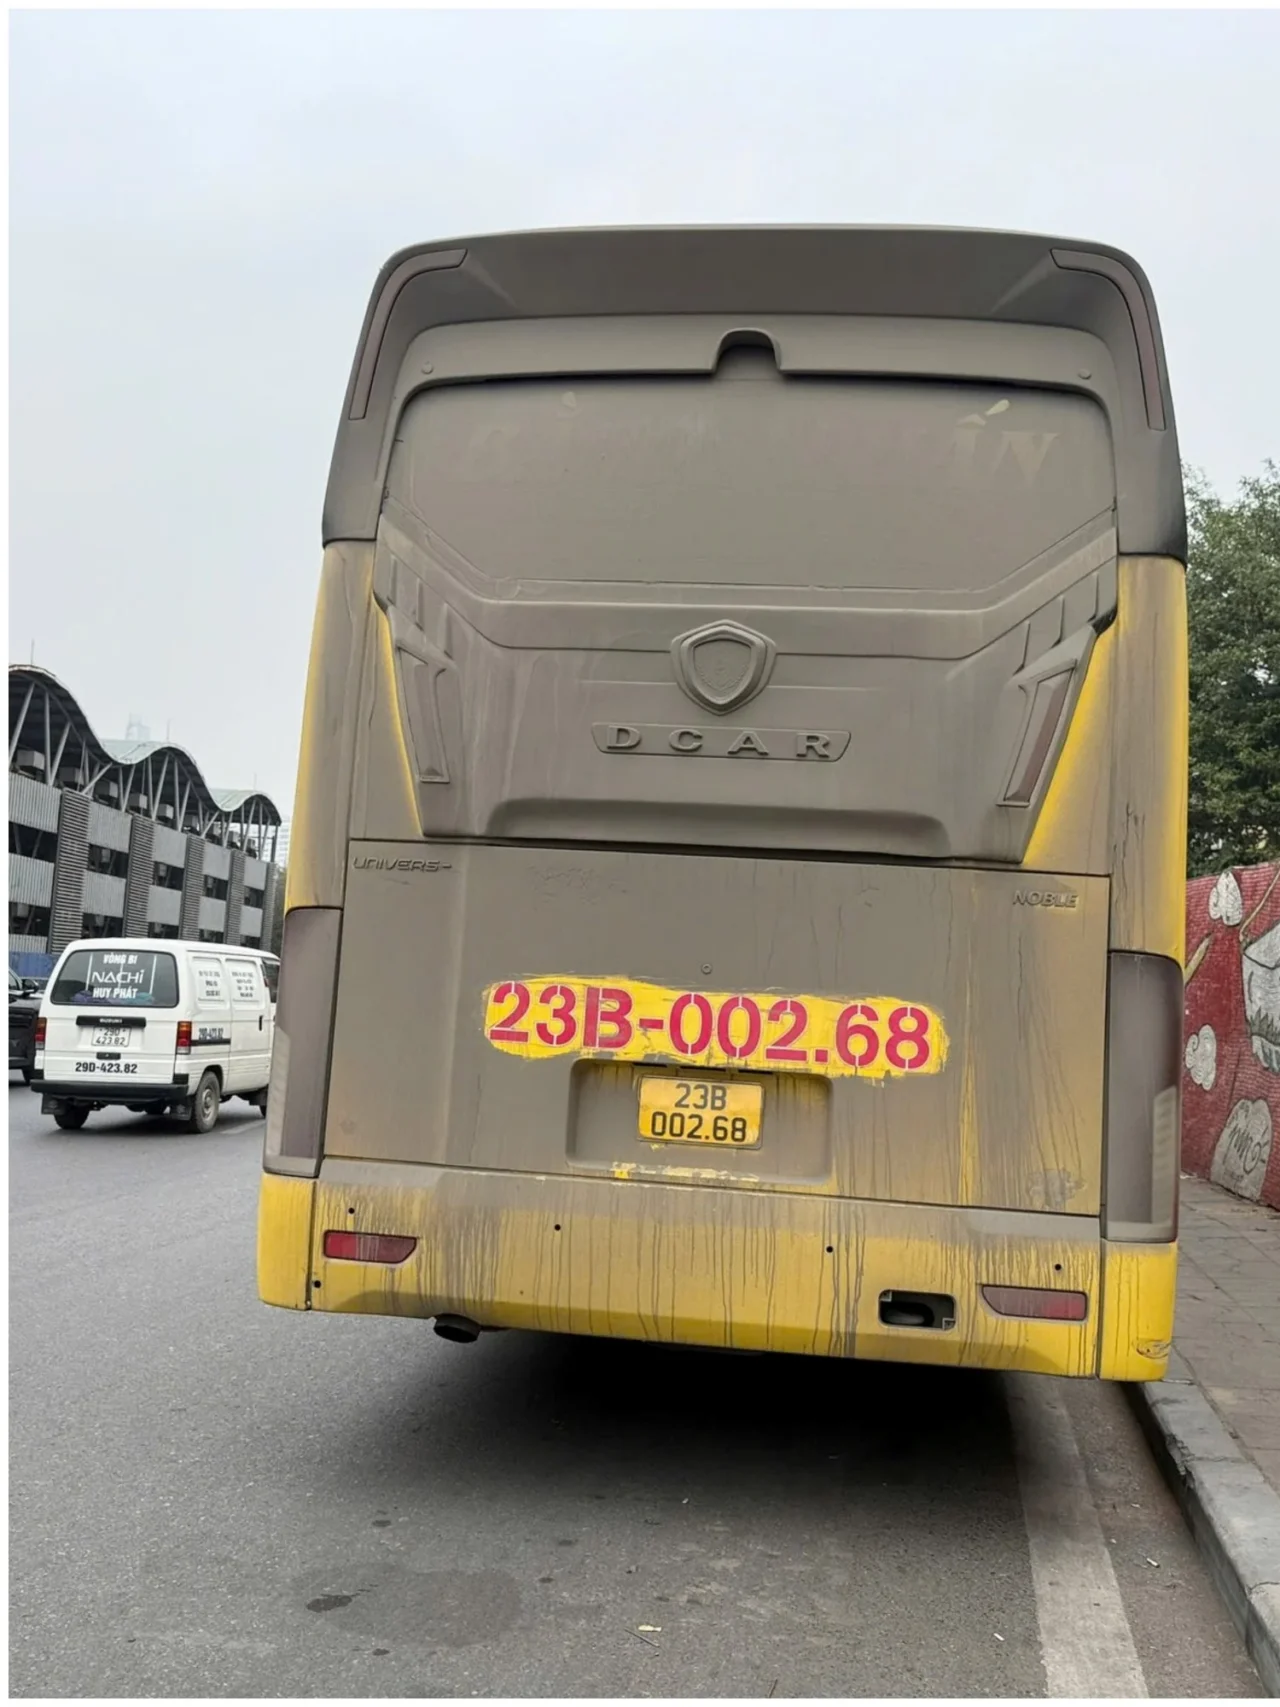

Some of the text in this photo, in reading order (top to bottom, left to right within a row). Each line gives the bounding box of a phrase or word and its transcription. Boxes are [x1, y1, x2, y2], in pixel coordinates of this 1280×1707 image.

[606, 723, 832, 760] DCAR
[1012, 889, 1078, 909] NOBLE
[127, 954, 138, 965] BI
[92, 985, 139, 999] HUY PHÁT
[489, 980, 931, 1070] 23B-002.68
[75, 1060, 138, 1074] 29D-423.82
[674, 1082, 728, 1111] 23B
[650, 1111, 748, 1143] 002.68
